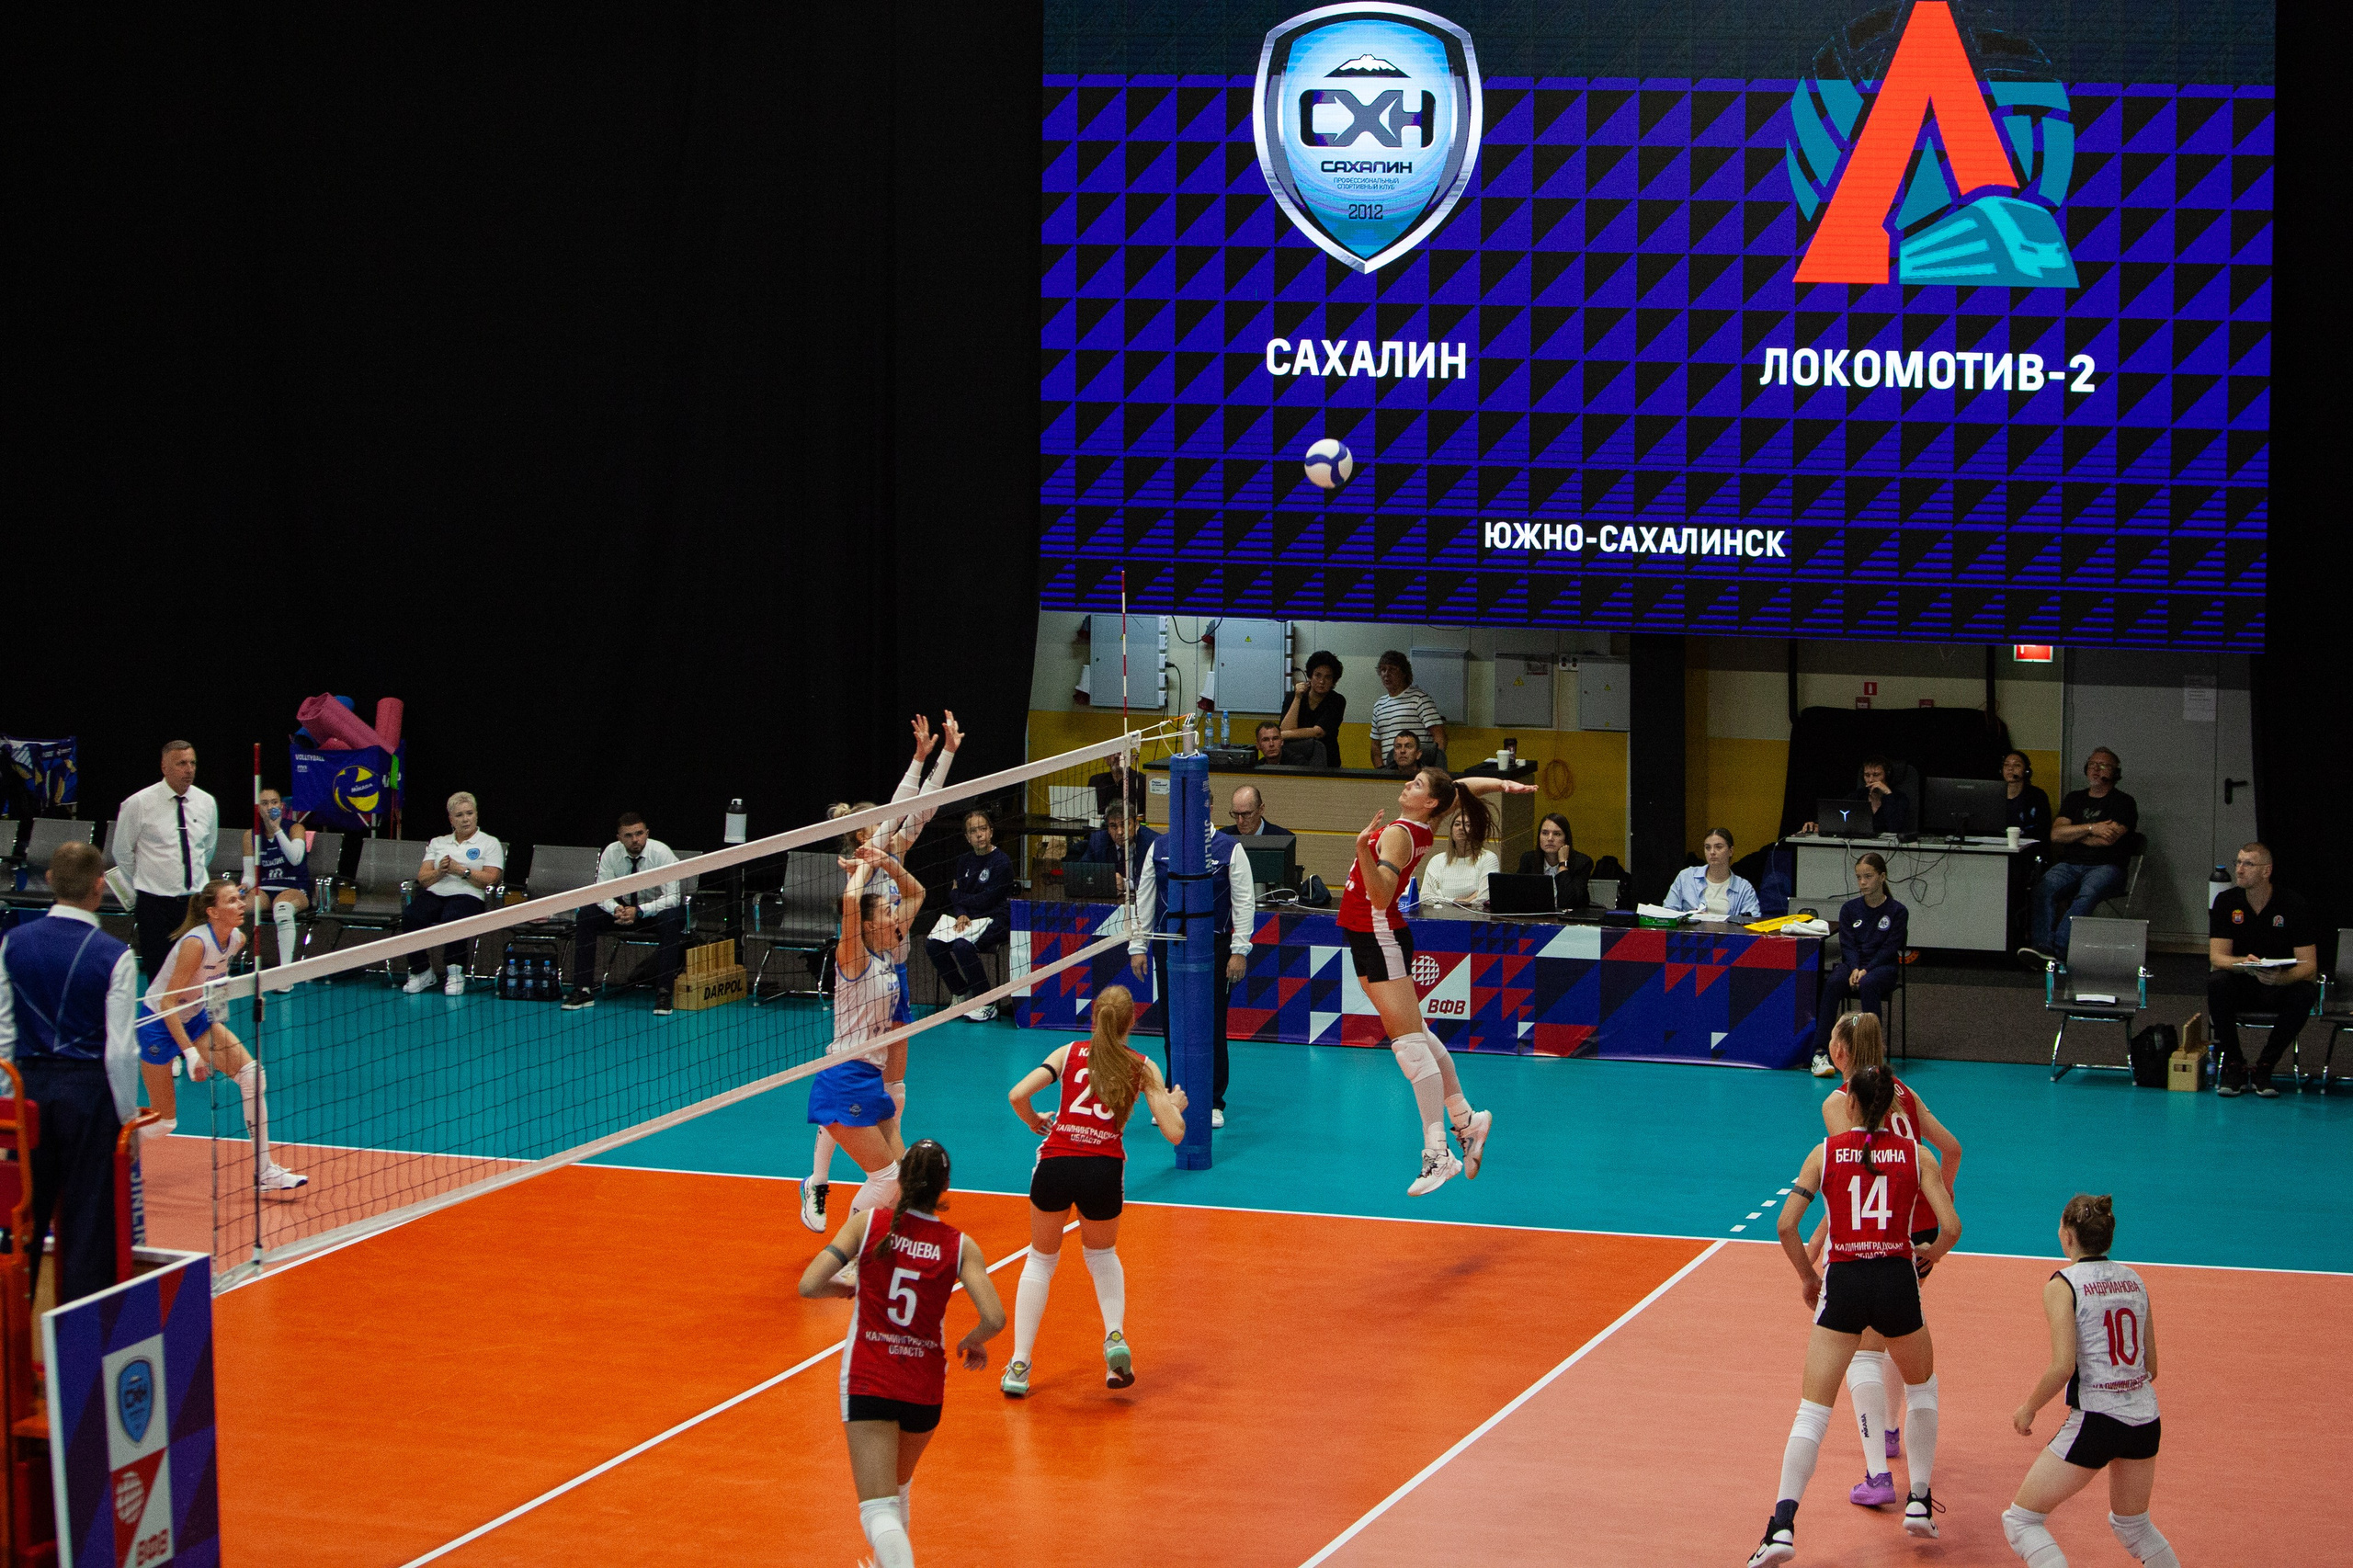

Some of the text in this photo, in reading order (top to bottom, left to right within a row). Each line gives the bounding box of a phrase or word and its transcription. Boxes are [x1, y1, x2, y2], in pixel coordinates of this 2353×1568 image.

[1348, 204, 1383, 220] 2012
[1266, 337, 1466, 379] САХАЛИН
[1759, 347, 2096, 392] ЛОКОМОТИВ-2
[1484, 521, 1786, 557] ЮЖНО-САХАЛИНСК
[704, 979, 743, 1000] DARPOL
[1427, 999, 1466, 1015] ВФВ
[1836, 1148, 1906, 1164] БЕЛЯКИНА
[1847, 1176, 1893, 1231] 14
[887, 1267, 921, 1327] 5
[2083, 1280, 2141, 1296] АНДРИАНОВА
[2103, 1307, 2139, 1367] 10
